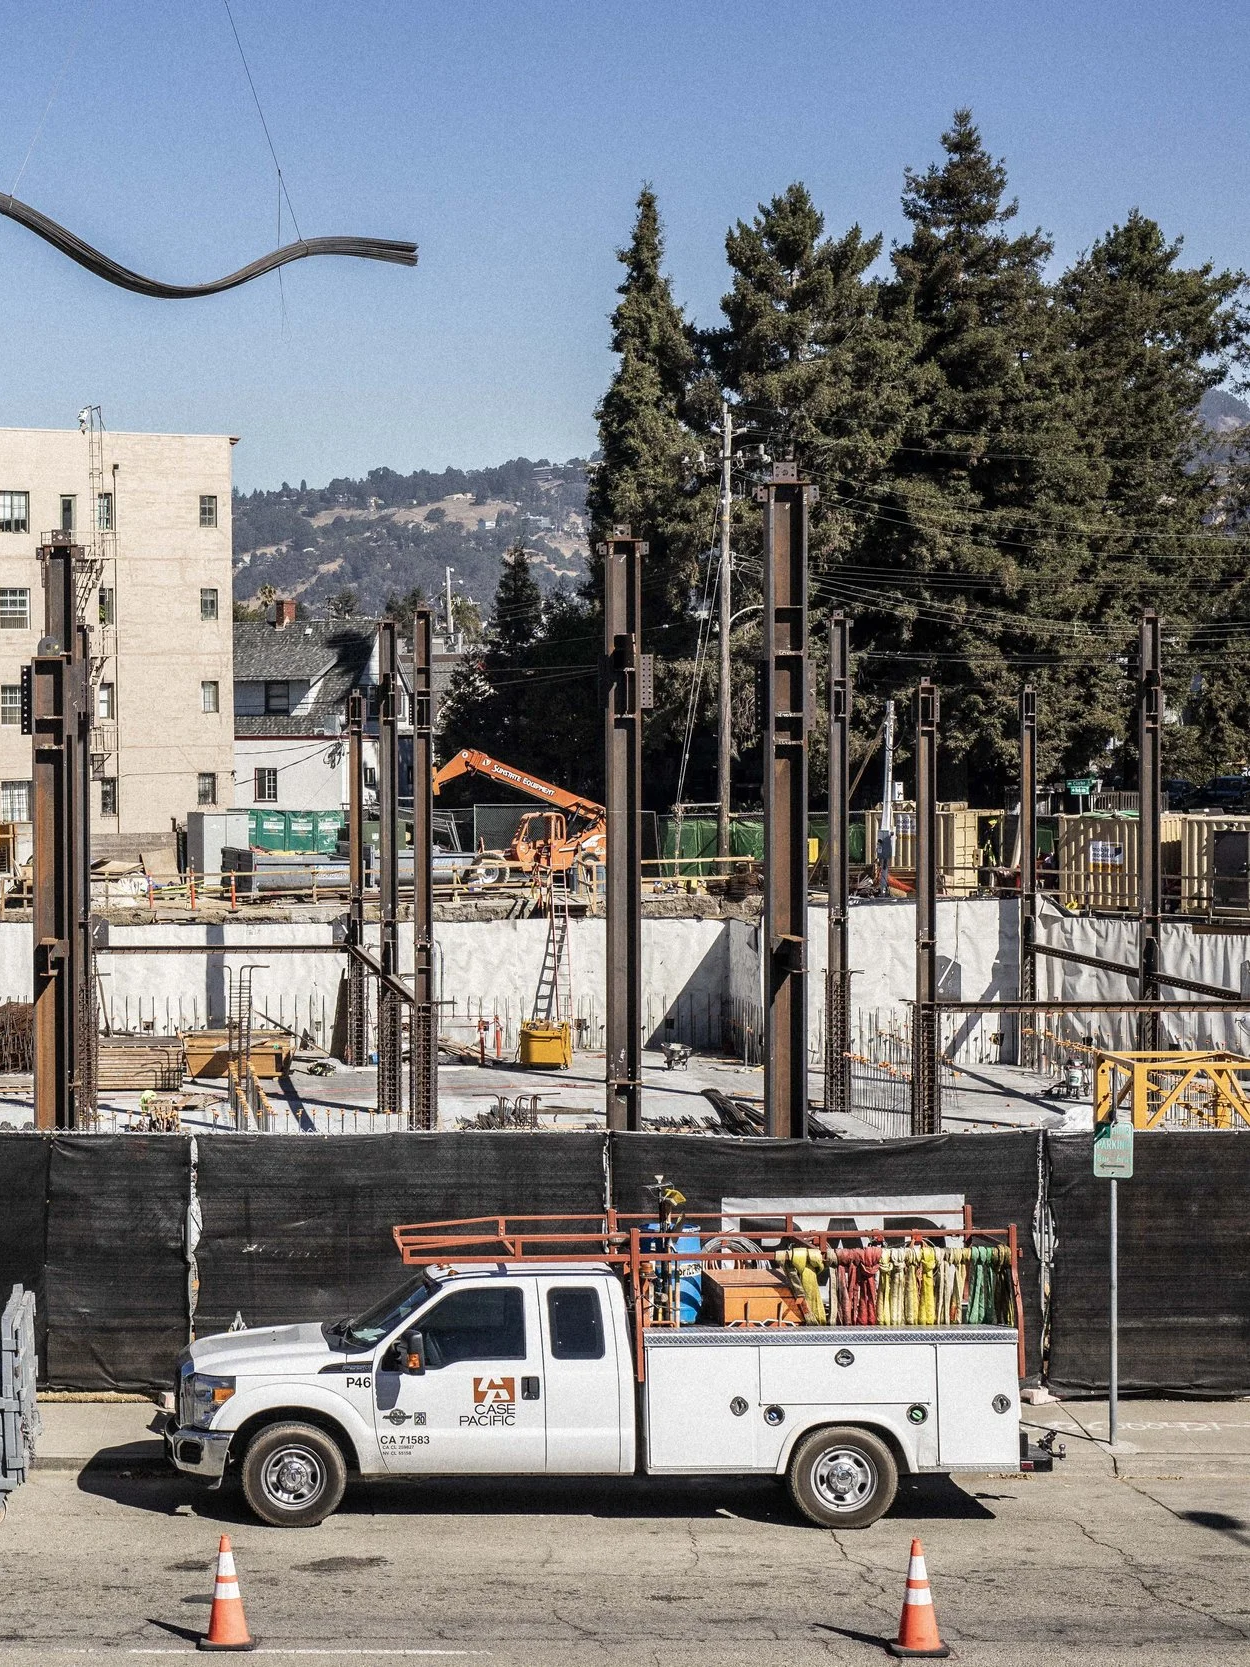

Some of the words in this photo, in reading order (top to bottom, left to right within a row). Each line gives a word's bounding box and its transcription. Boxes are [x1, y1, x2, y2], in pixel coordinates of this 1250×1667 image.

[491, 764, 522, 783] SUNSTATE
[522, 777, 556, 796] EQUIPMENT
[346, 1377, 371, 1388] P46
[474, 1404, 516, 1415] CASE
[459, 1415, 516, 1426] PACIFIC
[380, 1435, 396, 1444] CA
[399, 1435, 430, 1444] 71583
